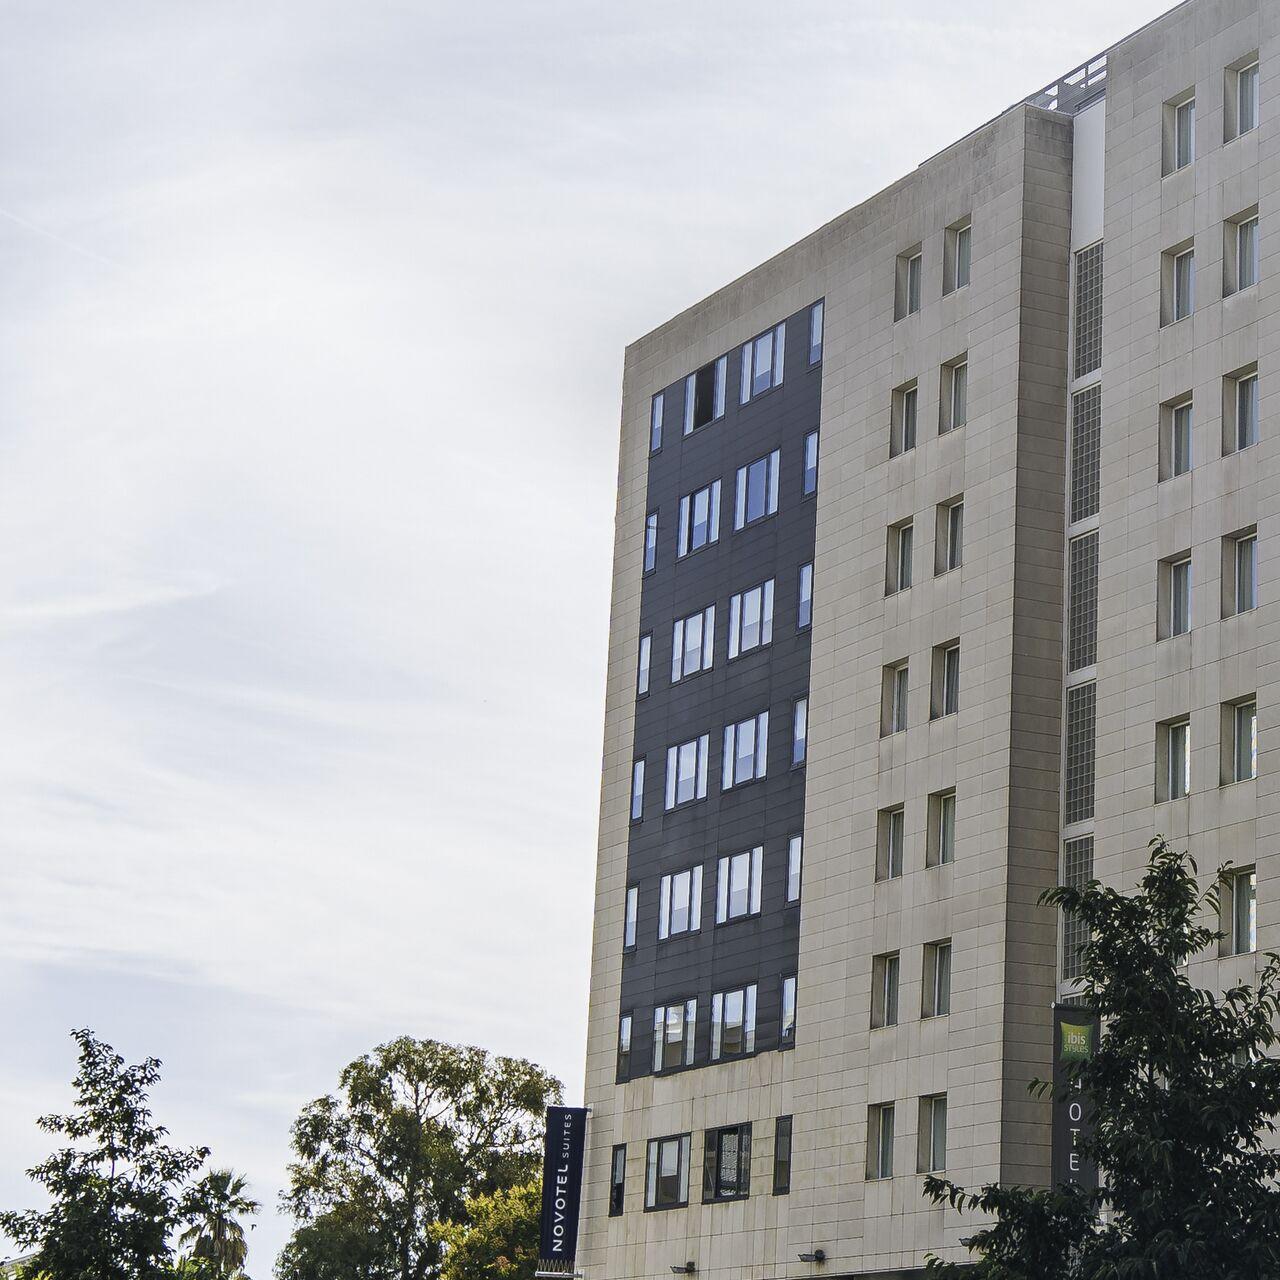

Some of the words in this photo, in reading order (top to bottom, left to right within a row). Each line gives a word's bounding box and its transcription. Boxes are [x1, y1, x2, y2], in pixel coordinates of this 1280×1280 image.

[1067, 1031, 1086, 1045] ibis
[552, 1164, 569, 1252] NOVOTEL
[562, 1113, 572, 1158] SUITES
